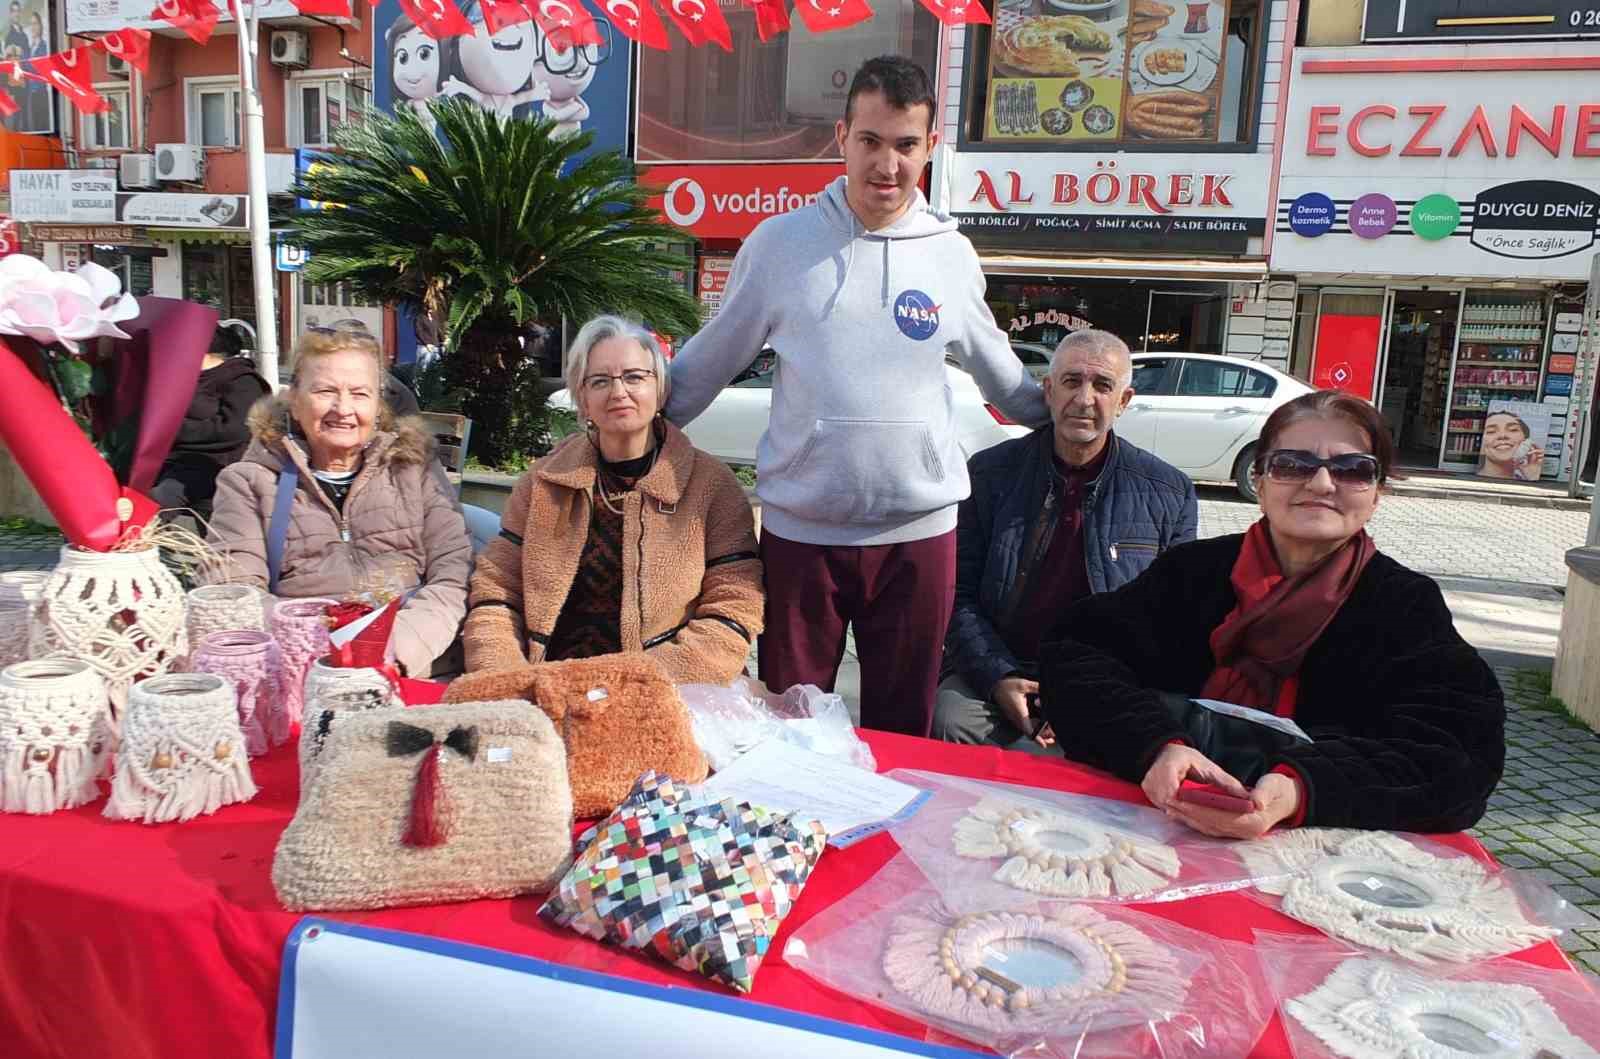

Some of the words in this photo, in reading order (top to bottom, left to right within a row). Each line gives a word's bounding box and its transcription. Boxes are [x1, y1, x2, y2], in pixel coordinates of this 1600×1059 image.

[1305, 103, 1600, 159] ECZANE
[19, 173, 61, 190] HAYAT
[969, 169, 1034, 212] AL
[1051, 159, 1234, 214] BÖREK
[1297, 206, 1328, 214] Dermo
[1361, 207, 1385, 215] Anne
[1418, 212, 1454, 222] Vitamin
[1478, 203, 1539, 217] DUYGU
[1543, 200, 1595, 218] DENİZ
[1035, 217, 1080, 228] POĞAÇA
[1095, 217, 1127, 229] SİMİT
[1129, 219, 1161, 230] AÇMA
[1173, 220, 1204, 230] SADE
[1206, 220, 1248, 231] BÖREK
[897, 305, 938, 324] NASA
[1009, 315, 1032, 332] AL
